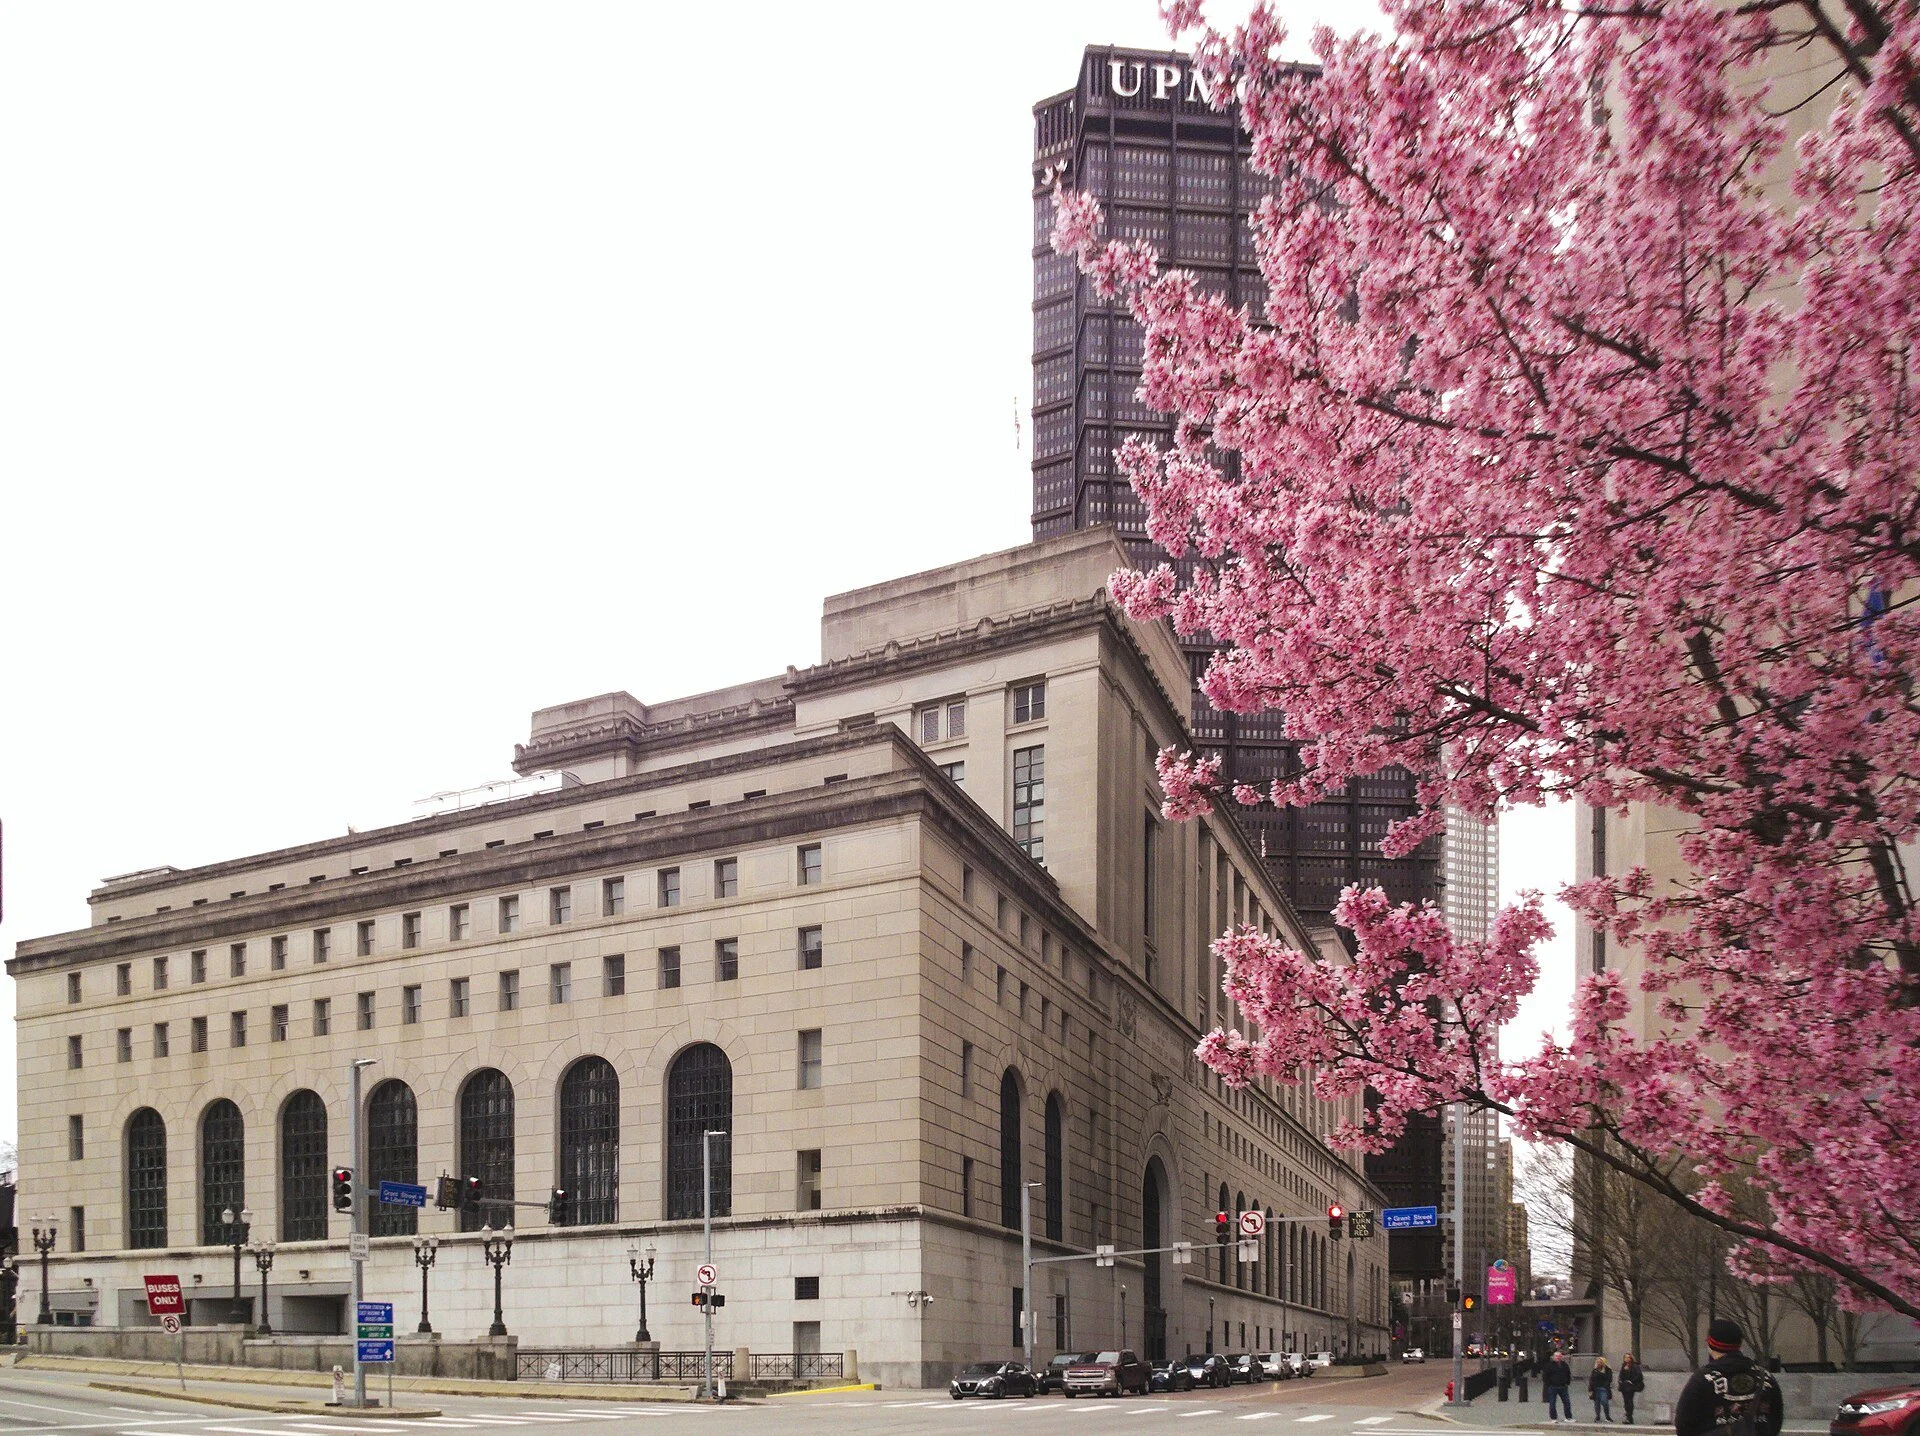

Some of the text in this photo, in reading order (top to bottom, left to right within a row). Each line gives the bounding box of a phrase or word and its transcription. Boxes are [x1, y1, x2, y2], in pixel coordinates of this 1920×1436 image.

[400, 1191, 417, 1199] Street
[390, 1196, 409, 1205] Liberty
[147, 1284, 180, 1293] BUSES
[153, 1296, 178, 1305] ONLY
